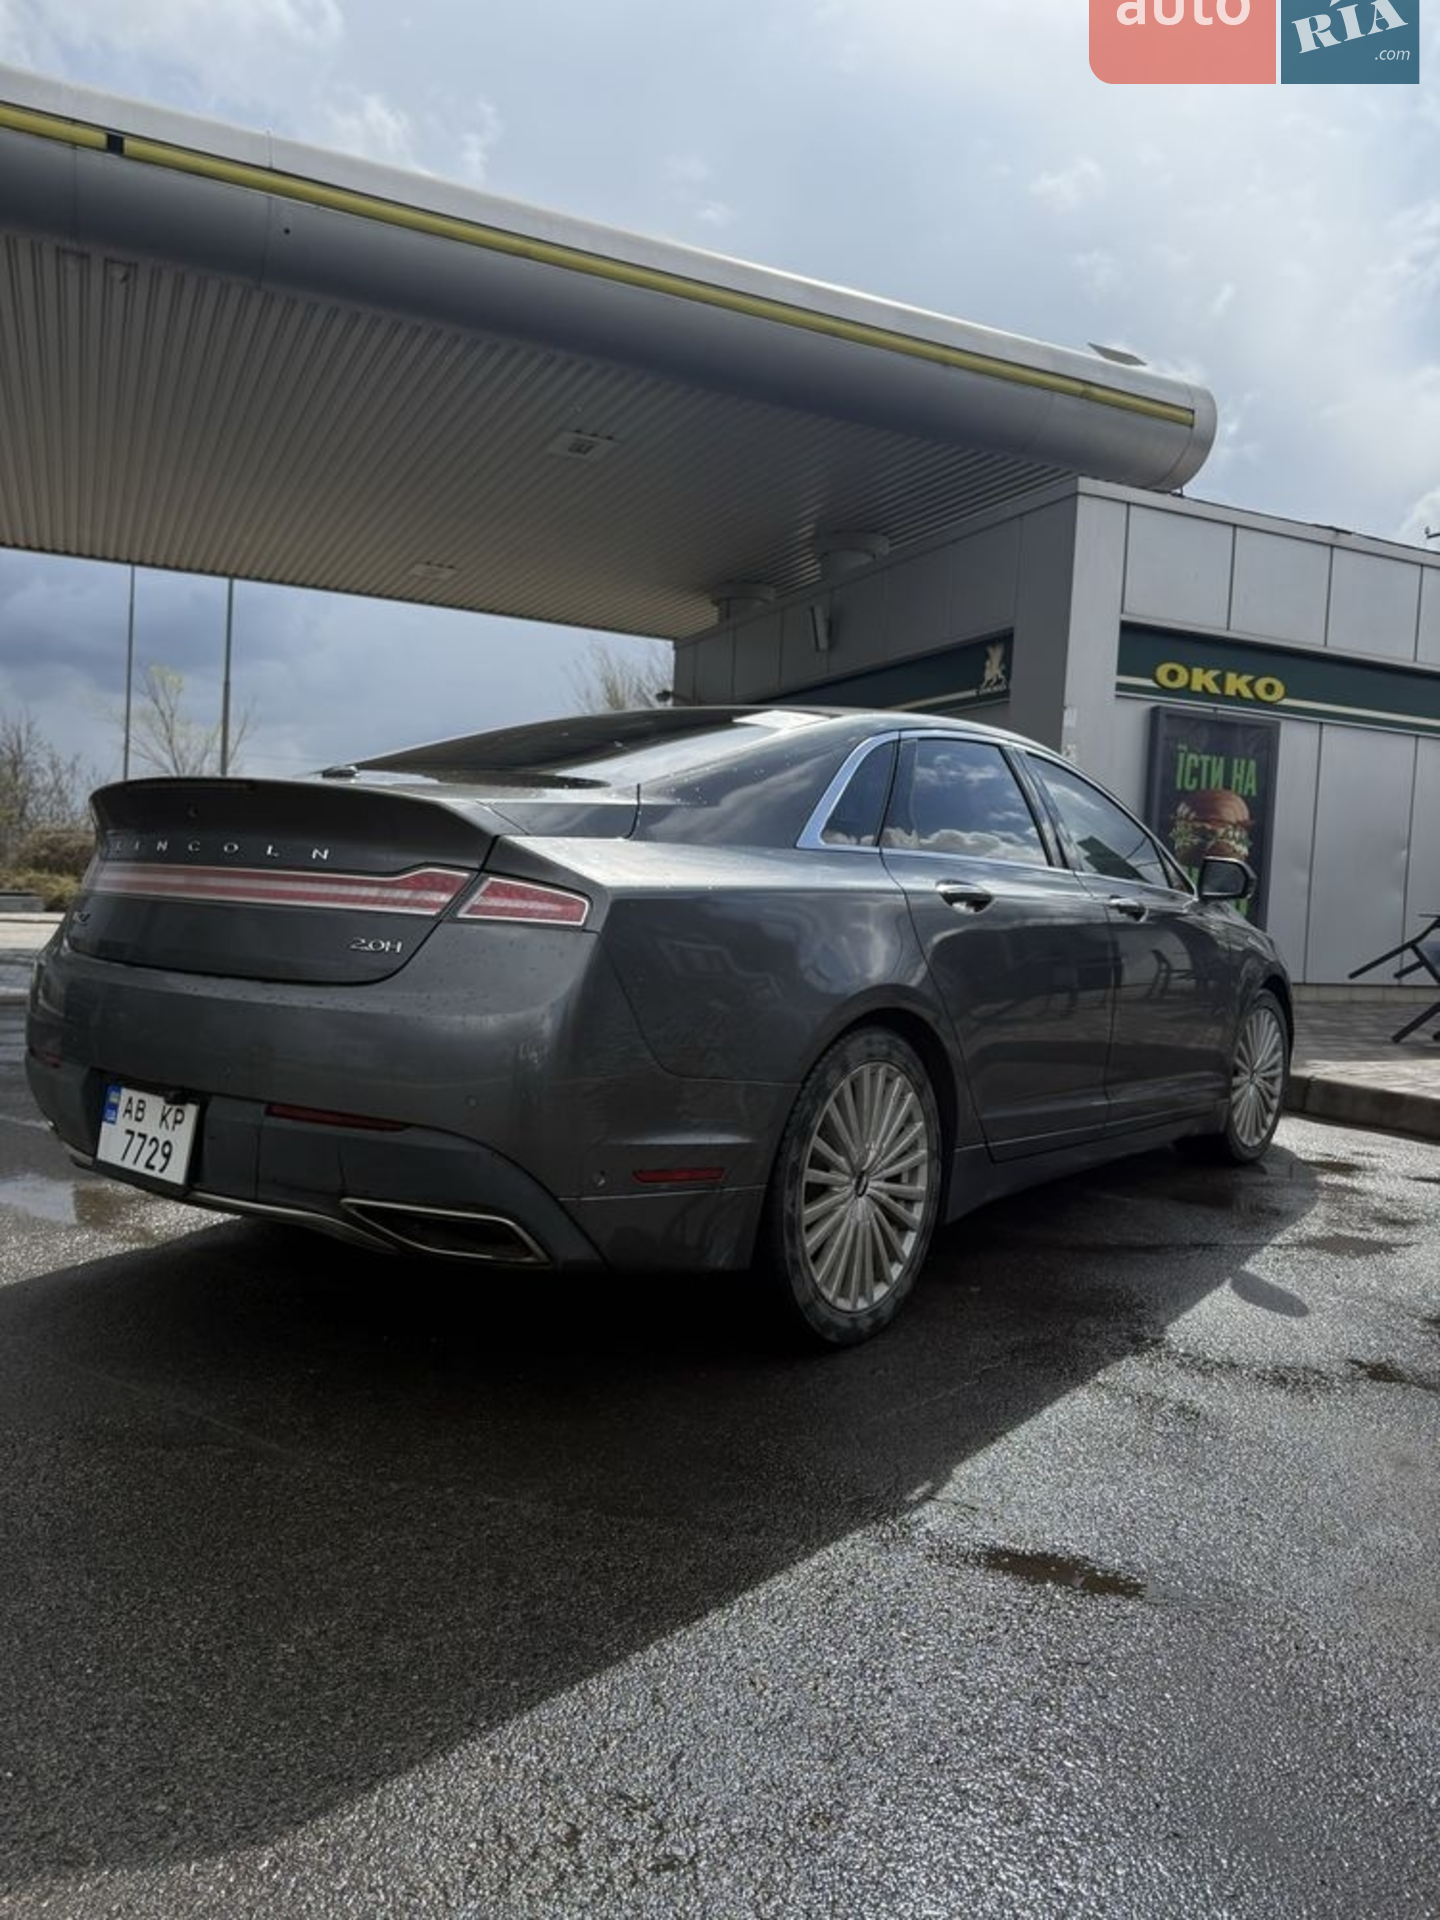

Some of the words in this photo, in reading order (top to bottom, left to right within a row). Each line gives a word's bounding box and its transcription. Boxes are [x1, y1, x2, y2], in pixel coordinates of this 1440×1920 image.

[1155, 661, 1286, 703] OKKO
[1175, 744, 1224, 791] ЇСТИ
[1231, 758, 1258, 797] НА
[122, 1096, 146, 1123] AB
[159, 1105, 186, 1132] KP
[121, 1128, 174, 1174] 7729
